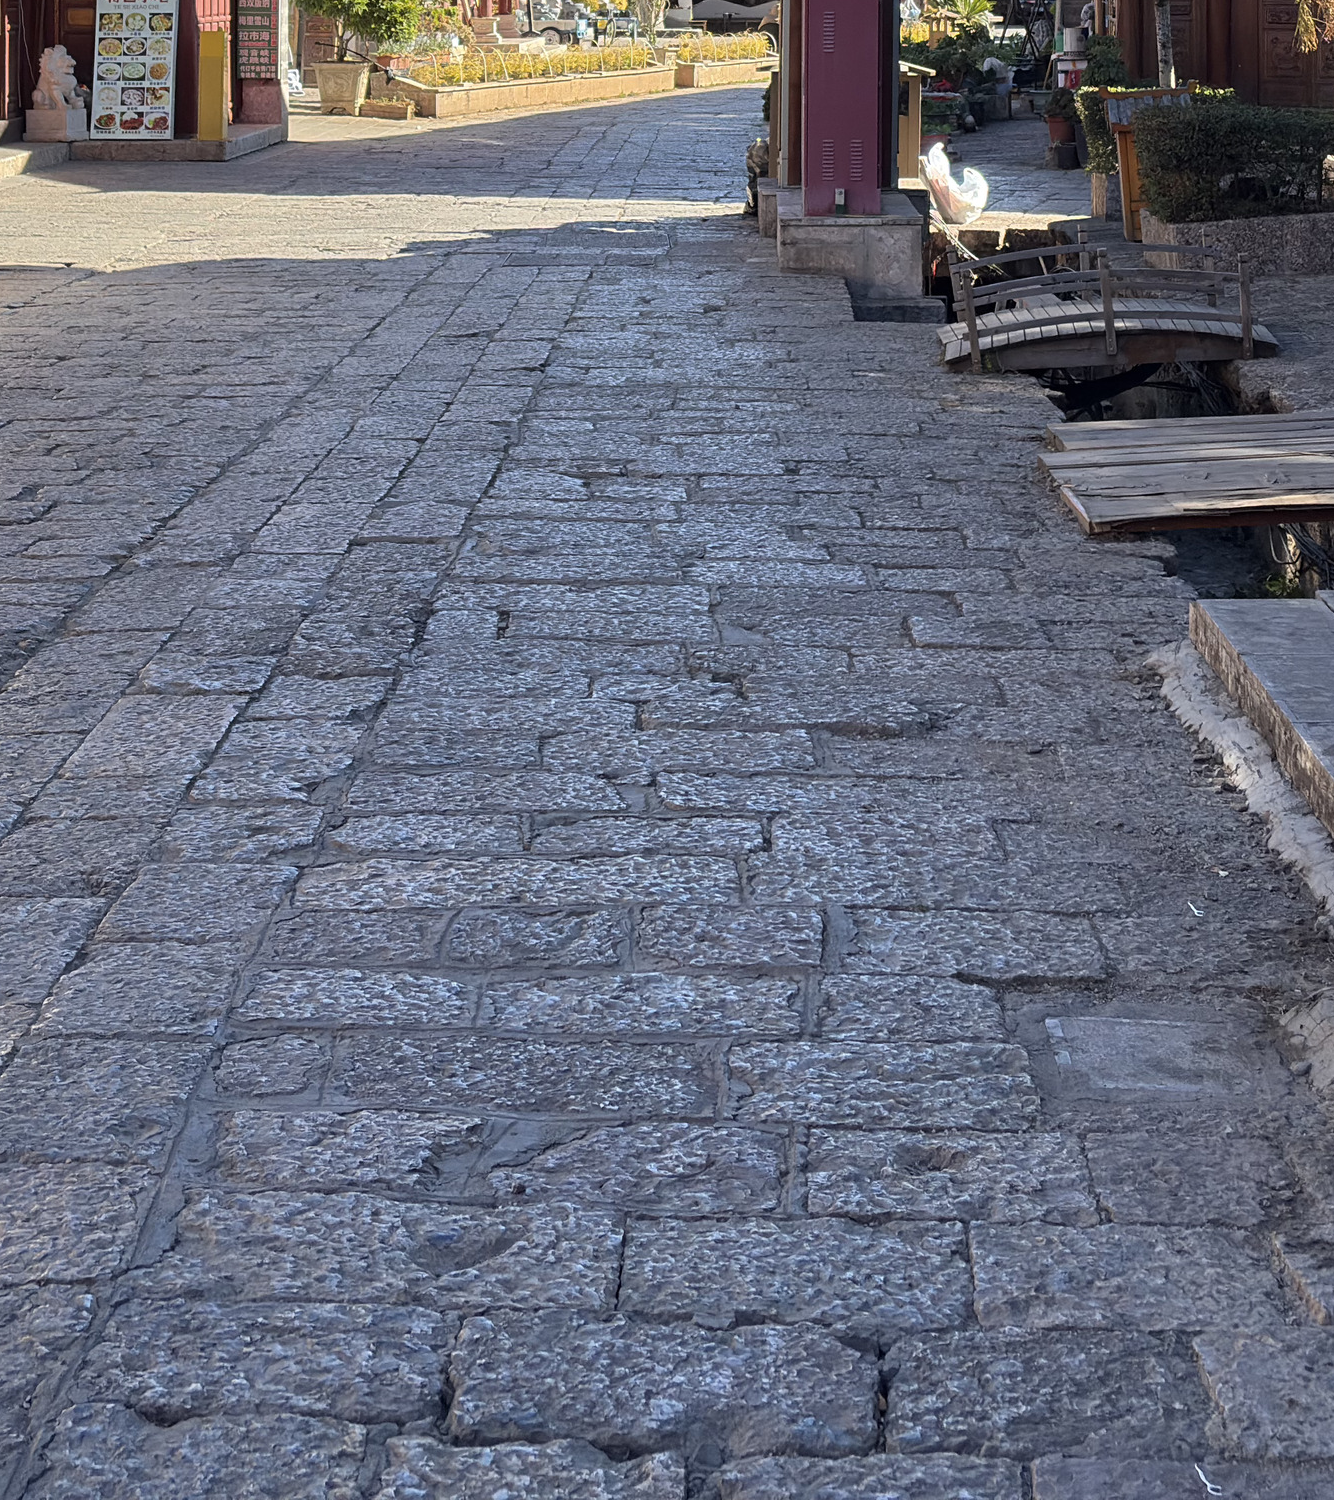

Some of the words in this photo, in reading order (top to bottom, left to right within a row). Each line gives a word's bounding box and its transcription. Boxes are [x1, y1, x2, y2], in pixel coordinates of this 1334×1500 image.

[238, 16, 270, 26] 梅里雪山
[238, 31, 270, 41] 拉市海
[239, 49, 270, 57] 观音峡
